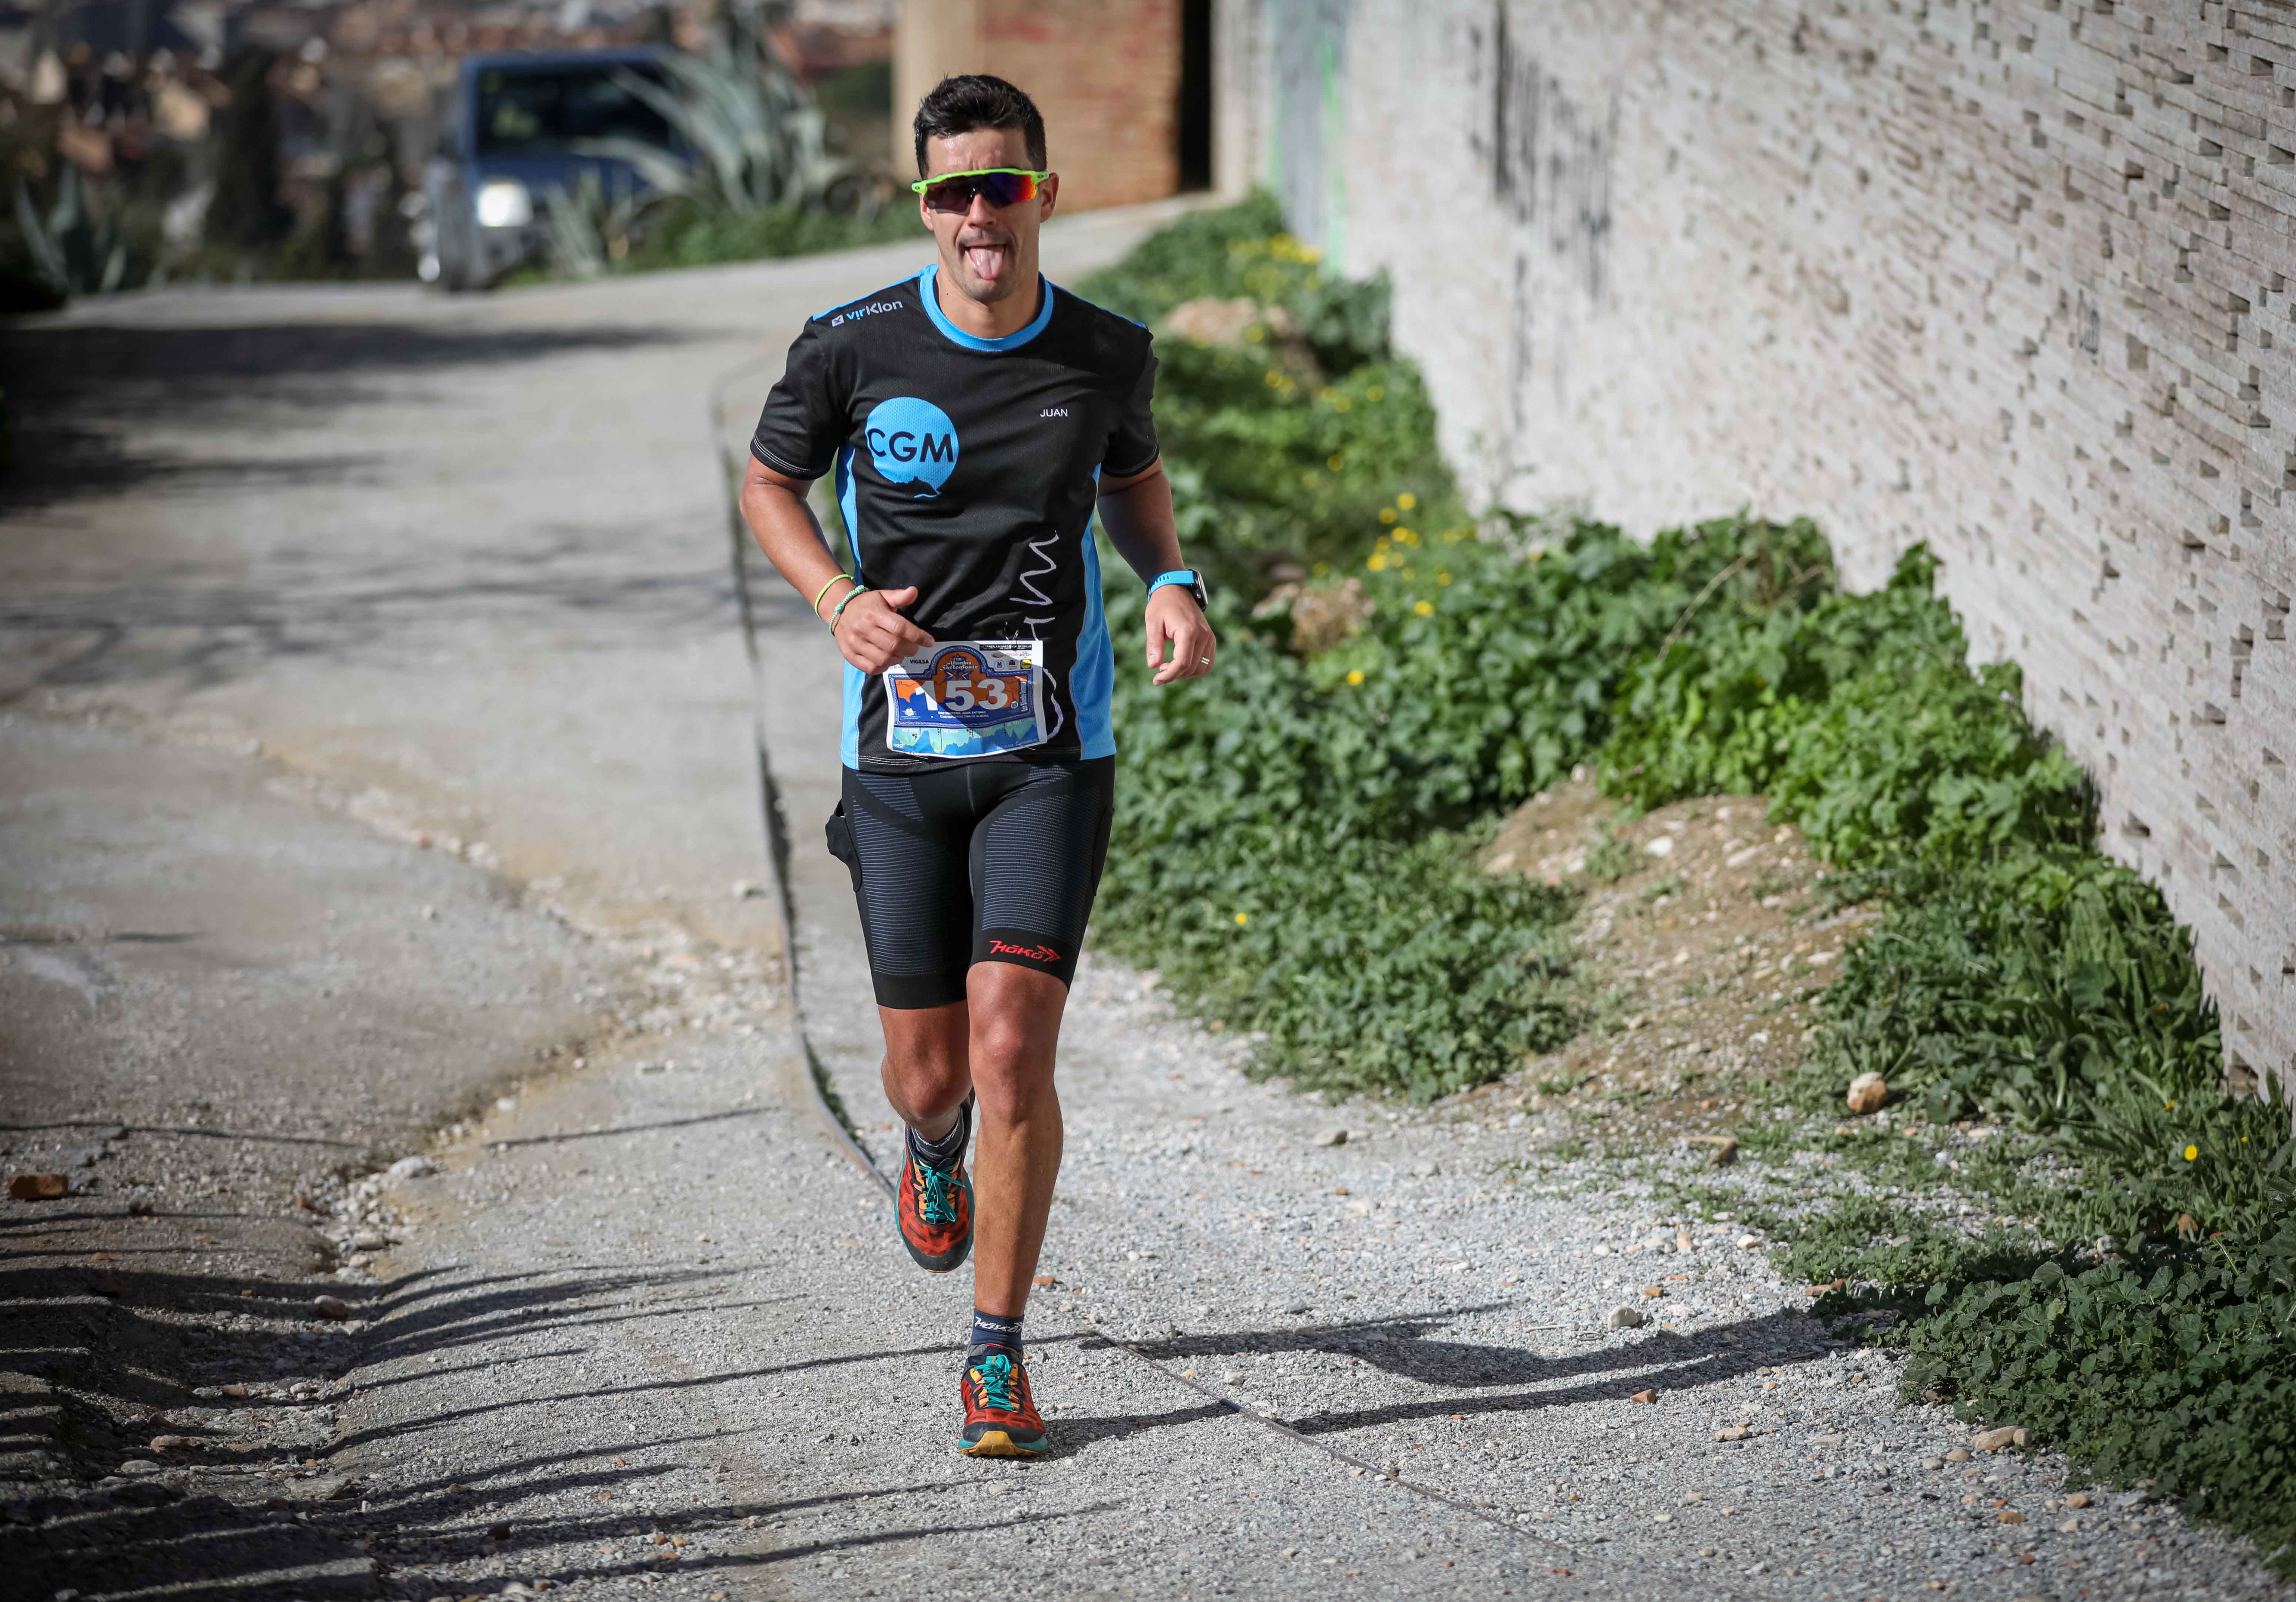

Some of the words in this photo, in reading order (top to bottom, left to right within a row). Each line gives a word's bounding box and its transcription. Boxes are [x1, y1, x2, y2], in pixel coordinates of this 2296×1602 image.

[1040, 409, 1068, 417] JUAN
[867, 428, 954, 462] CGM
[915, 679, 1008, 711] 153
